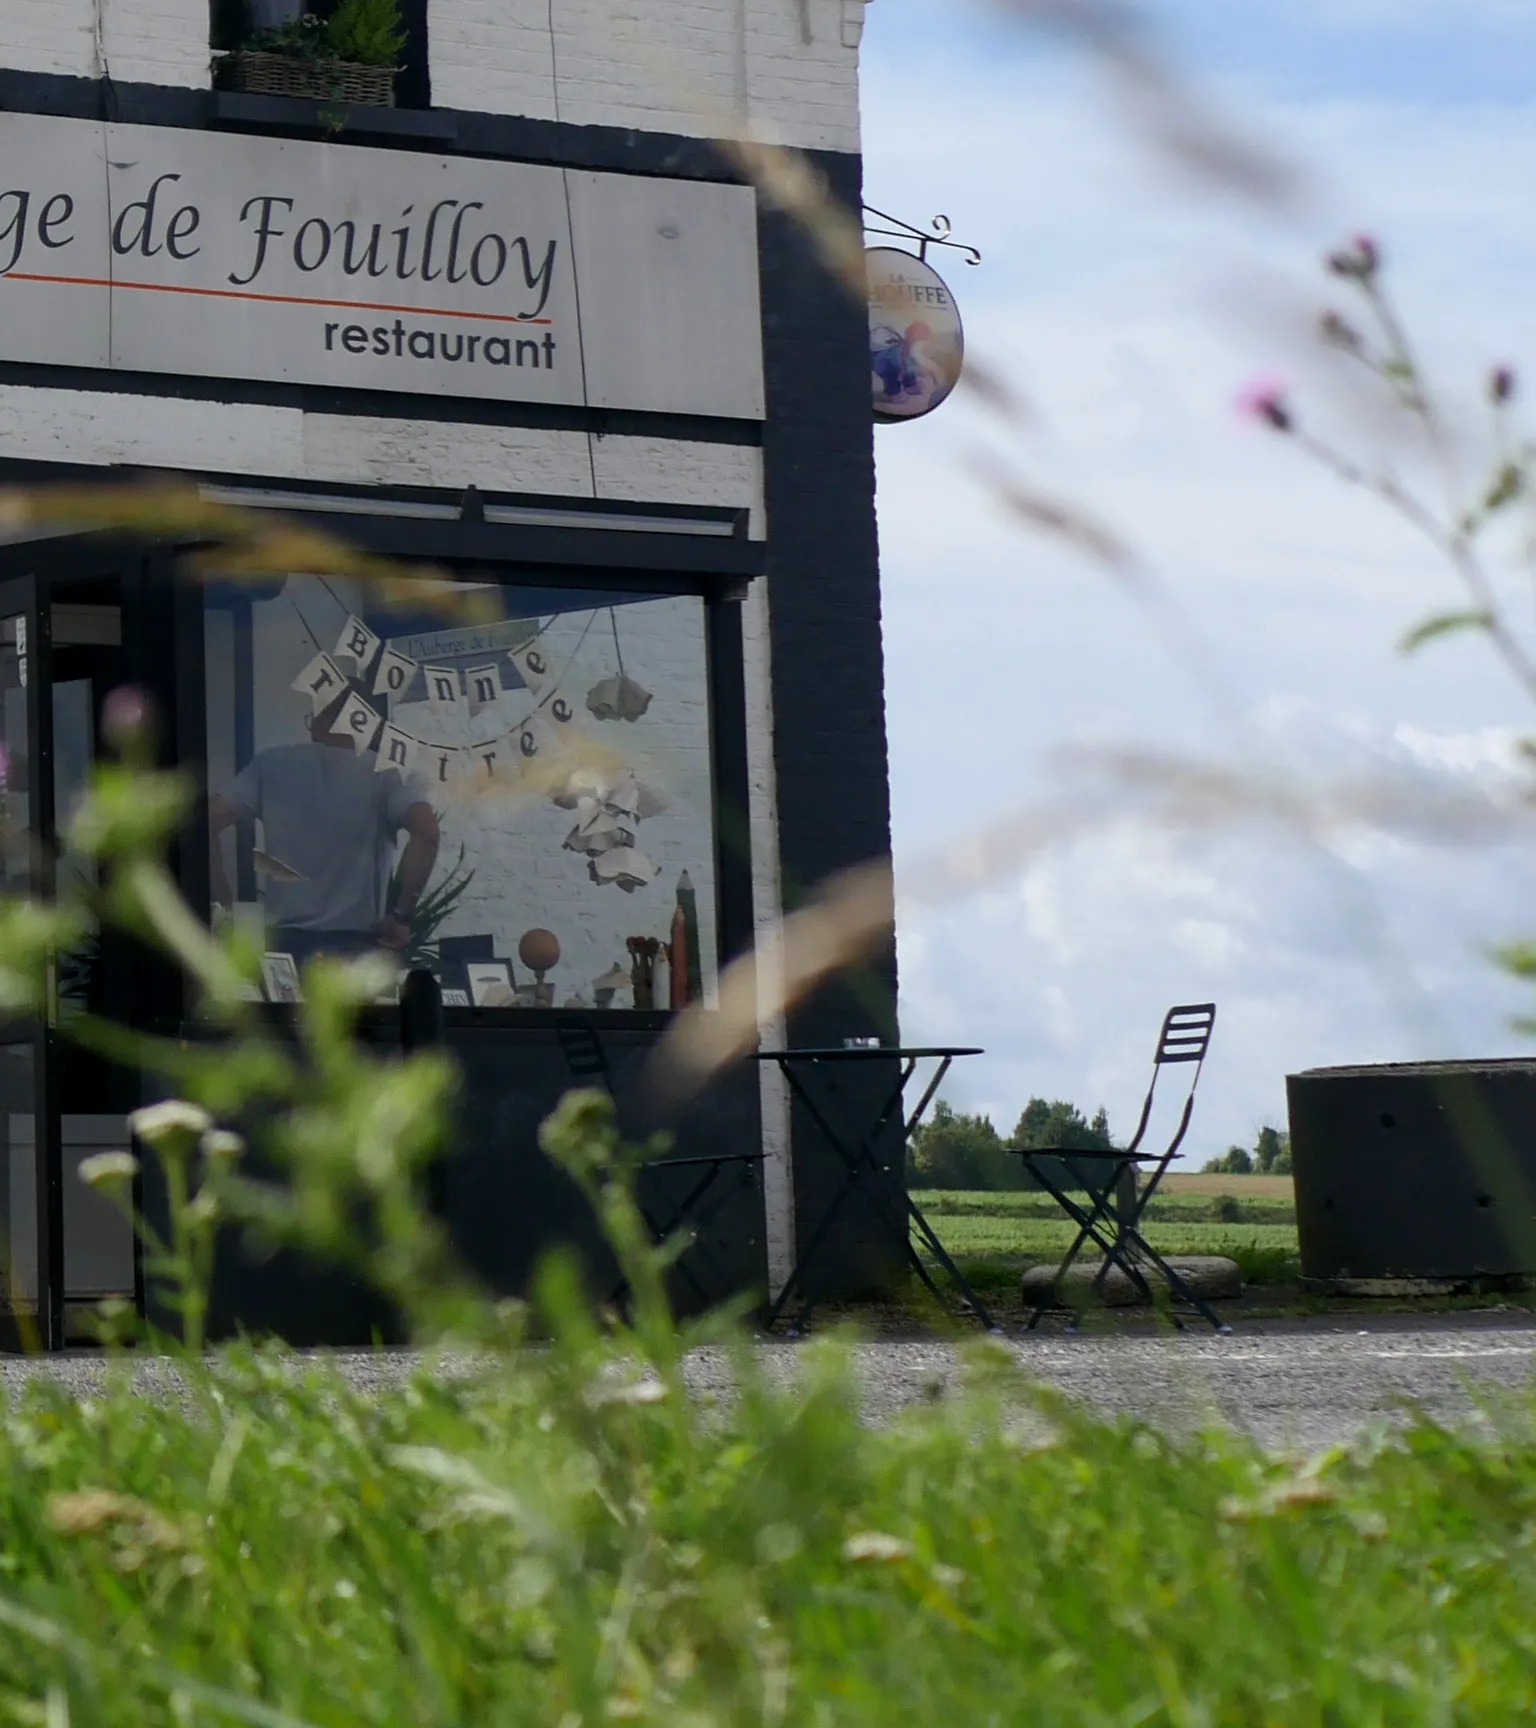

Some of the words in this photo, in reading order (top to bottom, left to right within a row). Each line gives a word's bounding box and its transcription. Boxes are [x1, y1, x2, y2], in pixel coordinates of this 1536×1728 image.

[111, 173, 201, 260] de
[228, 196, 557, 320] Fouilloy
[324, 319, 556, 370] restaurant
[346, 625, 546, 703] Bonne
